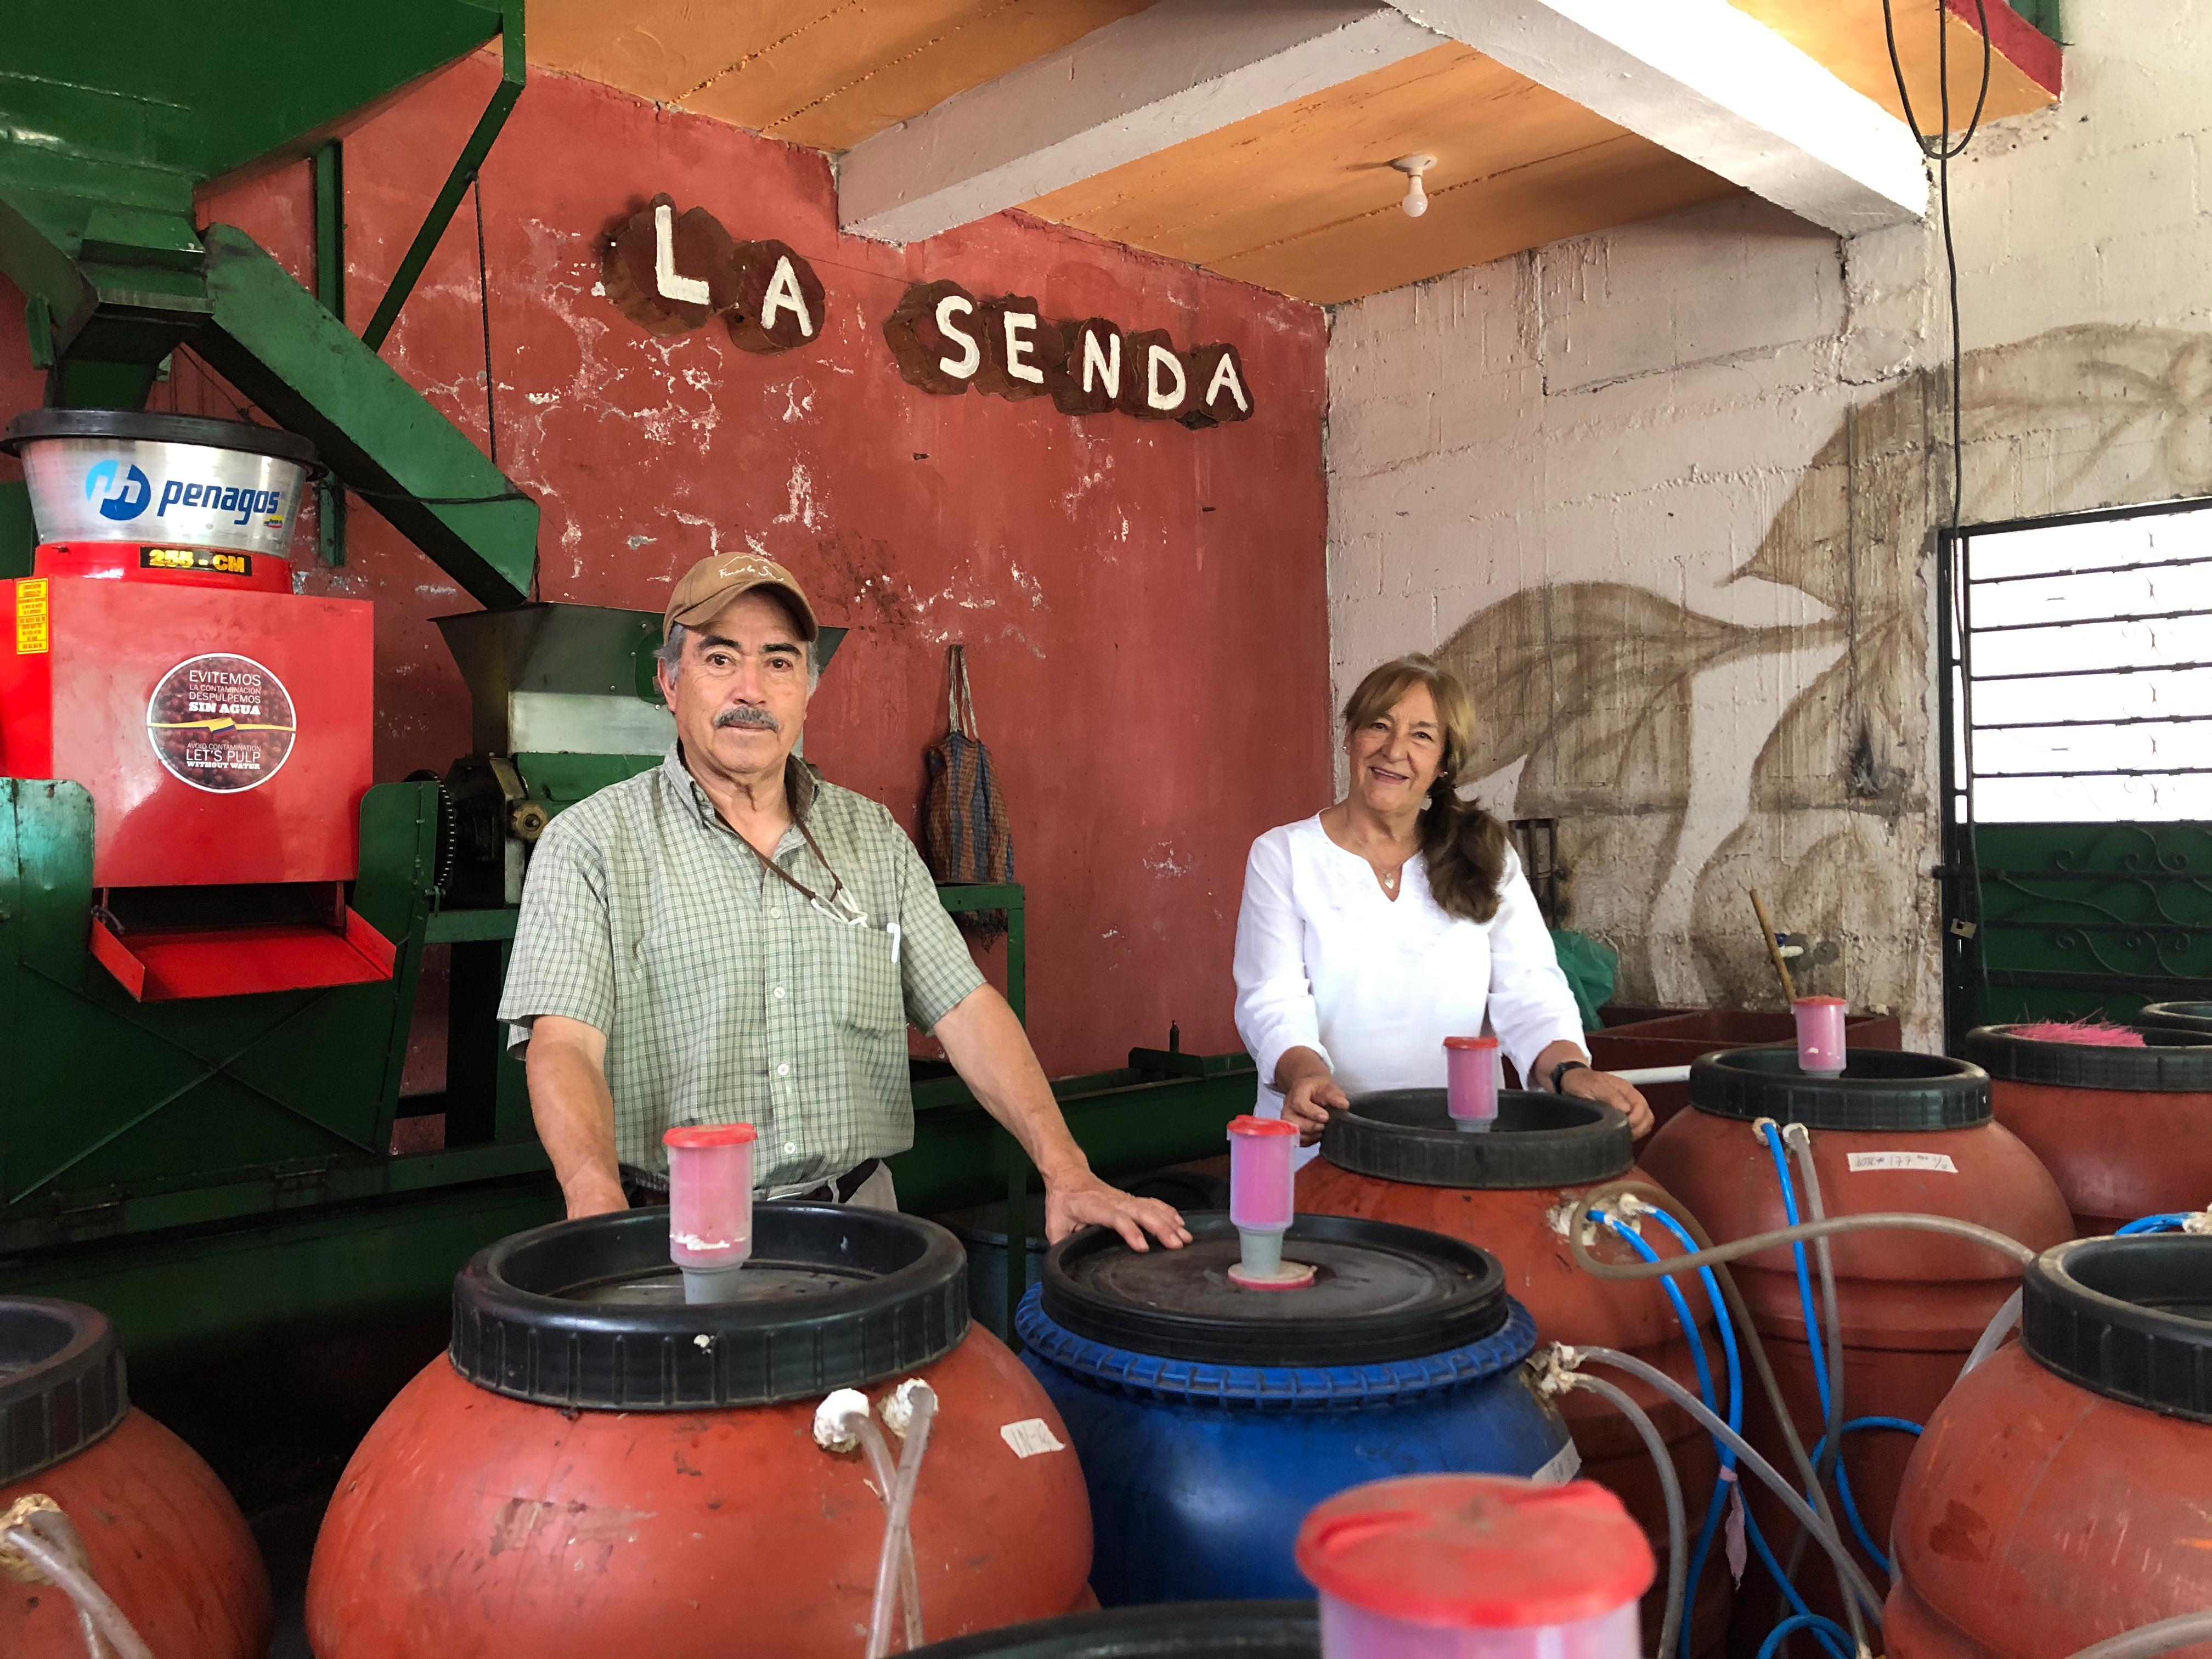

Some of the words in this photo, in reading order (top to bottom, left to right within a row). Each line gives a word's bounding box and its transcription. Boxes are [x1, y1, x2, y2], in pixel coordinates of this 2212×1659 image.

[655, 205, 813, 337] LA
[935, 295, 1248, 413] SENDA
[157, 479, 280, 526] penagos
[149, 549, 194, 568] 255
[212, 554, 245, 573] CM
[189, 670, 261, 686] EVITEMOS
[200, 684, 261, 695] CONTAMINACIÓN
[189, 691, 261, 704] DESPULPEMOS
[189, 702, 217, 713] SIN
[219, 703, 261, 715] AGUA
[208, 743, 261, 752] CONTAMINATION
[186, 748, 223, 762] LET'S
[227, 750, 261, 763] PULP
[186, 760, 229, 769] WITHOUT
